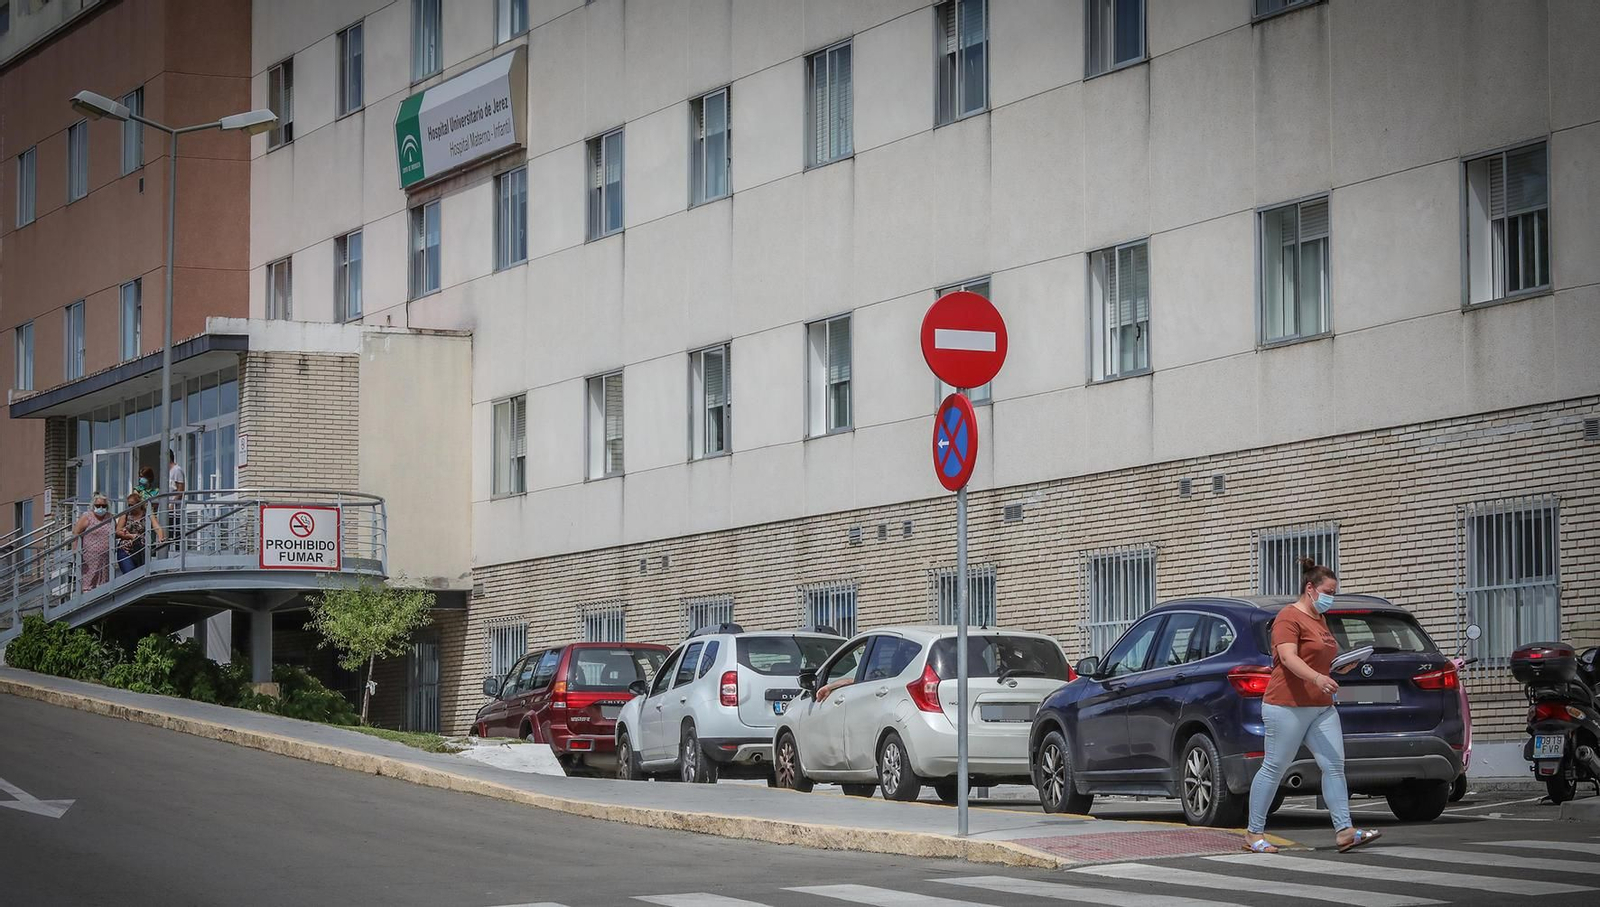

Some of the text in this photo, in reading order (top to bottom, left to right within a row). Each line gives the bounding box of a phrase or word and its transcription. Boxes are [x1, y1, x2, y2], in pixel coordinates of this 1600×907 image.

[427, 97, 509, 142] Hospital Universitario de Jerez
[449, 135, 470, 157] Hospital
[470, 130, 490, 148] Materno
[493, 118, 512, 138] Infantil
[266, 540, 335, 551] PROHIBIDO
[279, 552, 324, 562] FUMAR
[1541, 736, 1562, 745] 0919
[1542, 745, 1560, 754] FVR
